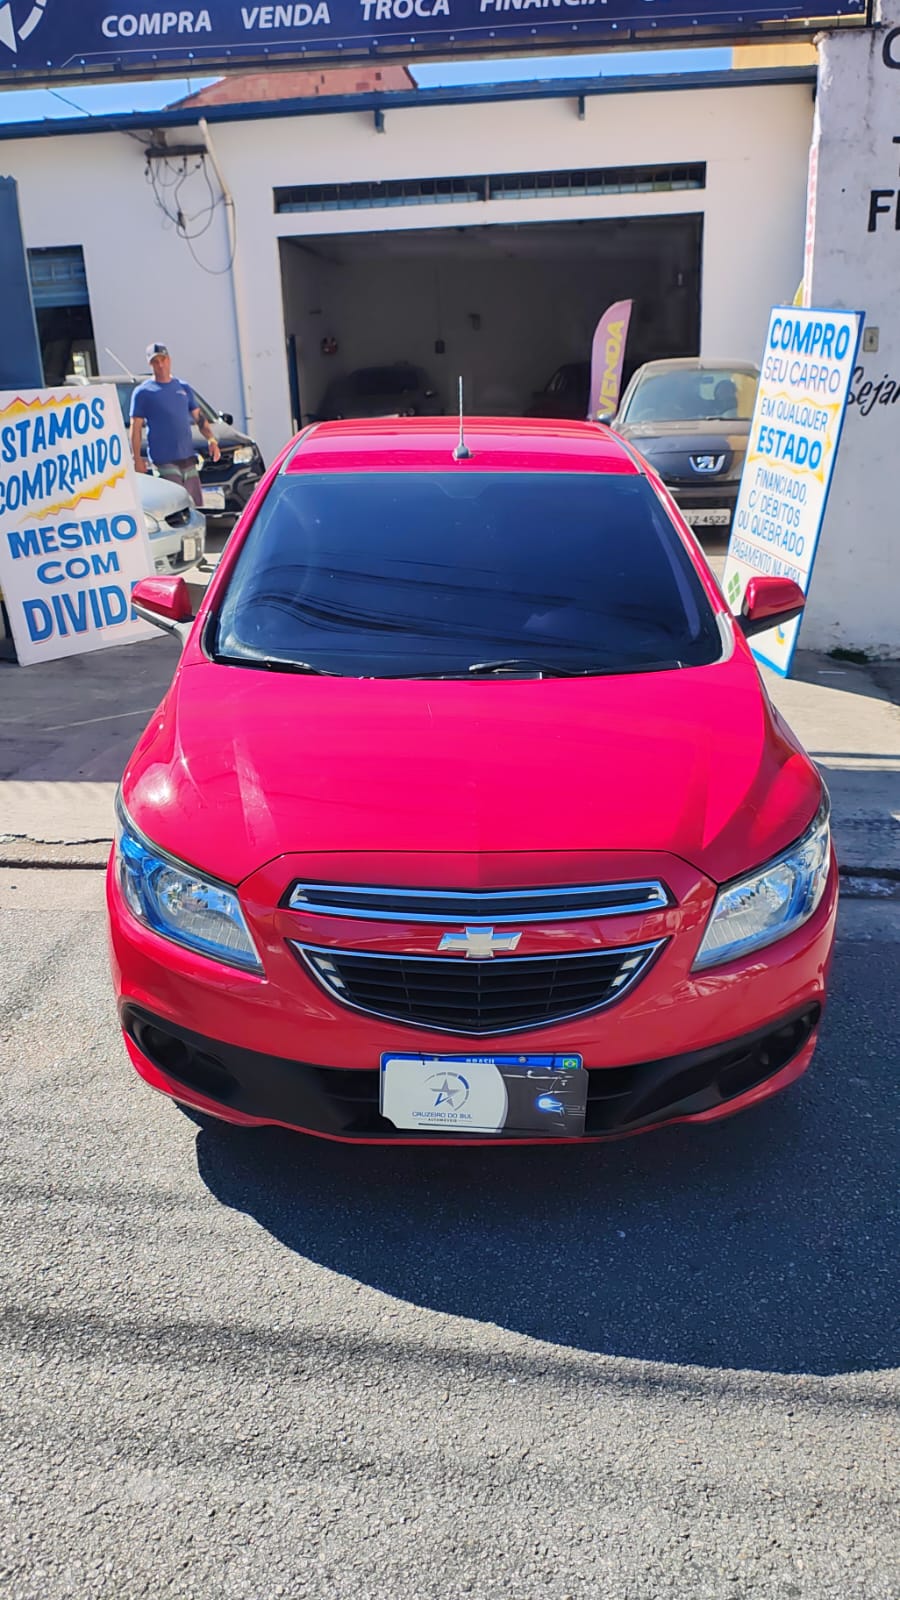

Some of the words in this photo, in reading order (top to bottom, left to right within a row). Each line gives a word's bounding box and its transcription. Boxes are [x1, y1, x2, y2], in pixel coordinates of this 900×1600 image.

[101, 10, 213, 38] COMPRA
[241, 2, 331, 29] VENDA
[360, 0, 450, 20] TROCA
[770, 318, 850, 360] COMPRO
[596, 319, 625, 417] VENDA
[764, 356, 789, 383] SEU
[790, 361, 841, 394] CARRO
[761, 397, 776, 417] EM
[776, 401, 829, 432] QUALQUER
[756, 426, 823, 470] ESTADO
[754, 467, 808, 506] FINANCIADO,
[7, 514, 138, 559] MESMO
[738, 509, 751, 530] OU
[751, 514, 805, 557] QUEBRADO
[36, 551, 120, 585] COM
[732, 537, 772, 573] PAGAMENTO
[411, 1111, 447, 1119] CRUZEIRO
